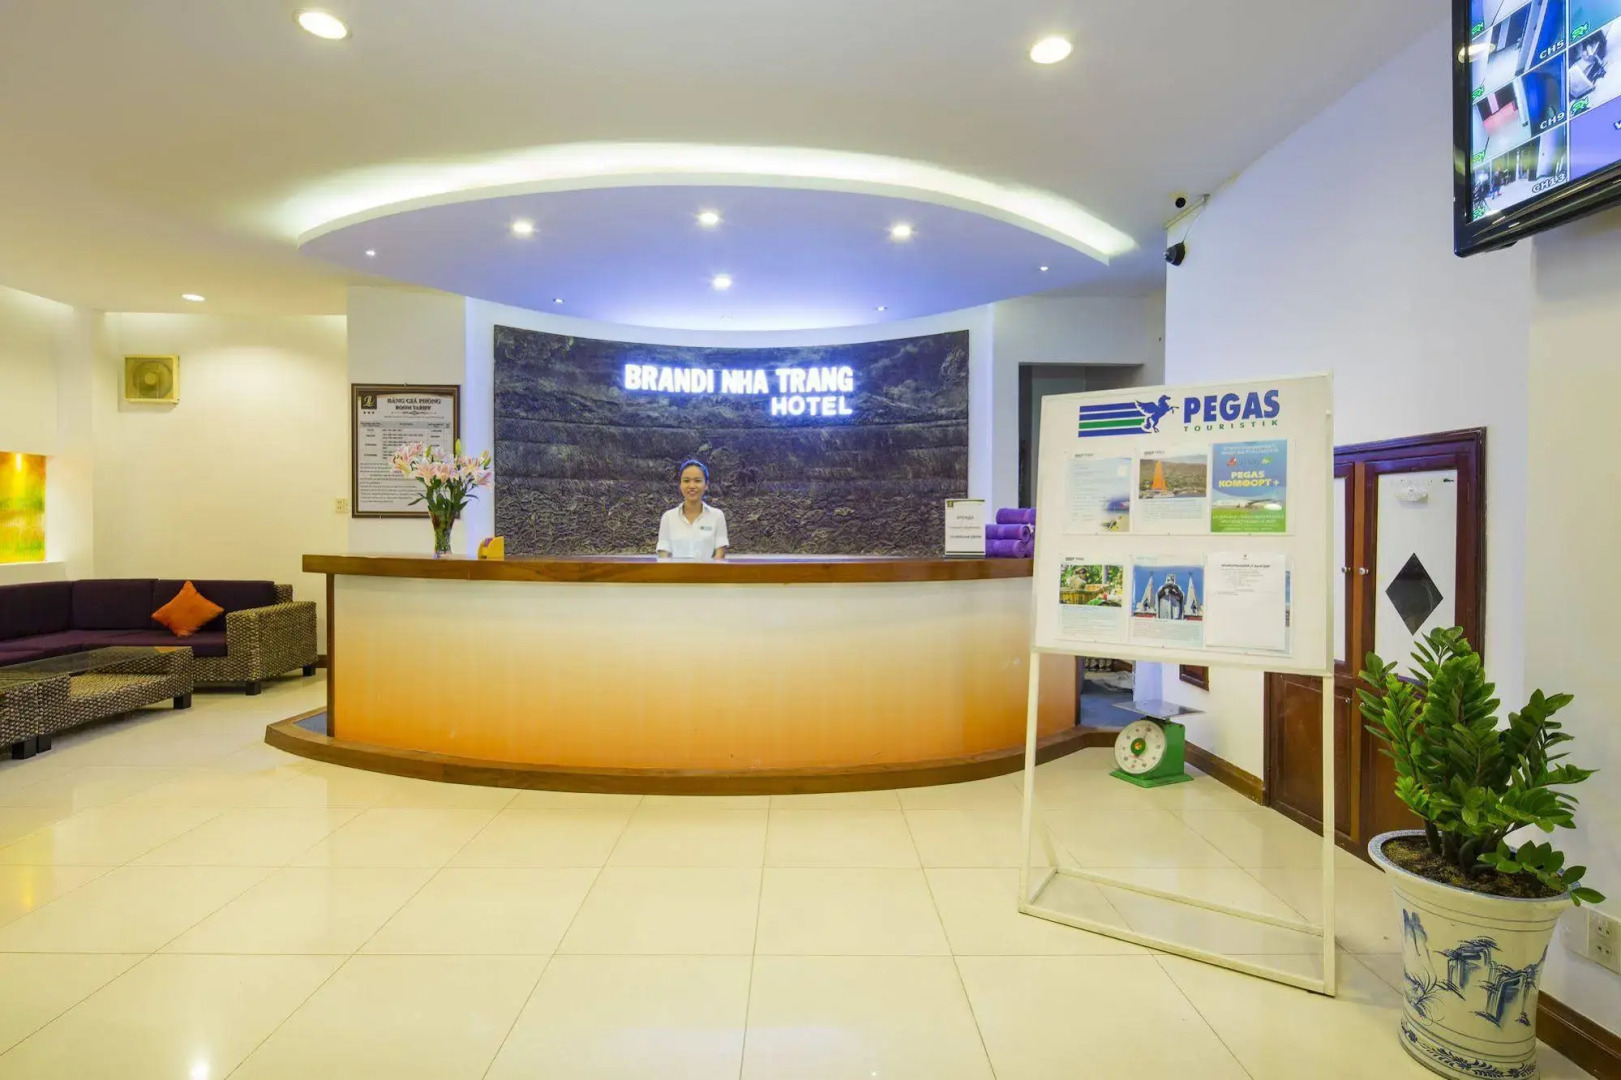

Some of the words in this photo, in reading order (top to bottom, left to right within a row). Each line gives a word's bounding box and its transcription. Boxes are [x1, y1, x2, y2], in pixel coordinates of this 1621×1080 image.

[1539, 40, 1565, 59] CH5
[1539, 112, 1565, 130] CH9
[624, 363, 714, 393] BRANDI
[721, 368, 769, 394] NHA
[775, 366, 854, 393] TRANG
[770, 395, 853, 416] HOTEL
[1182, 390, 1281, 424] PEGAS
[1183, 419, 1279, 432] TOURISTIK
[1218, 479, 1271, 488] КОМФОРТ
[1231, 470, 1265, 479] PEGAS
